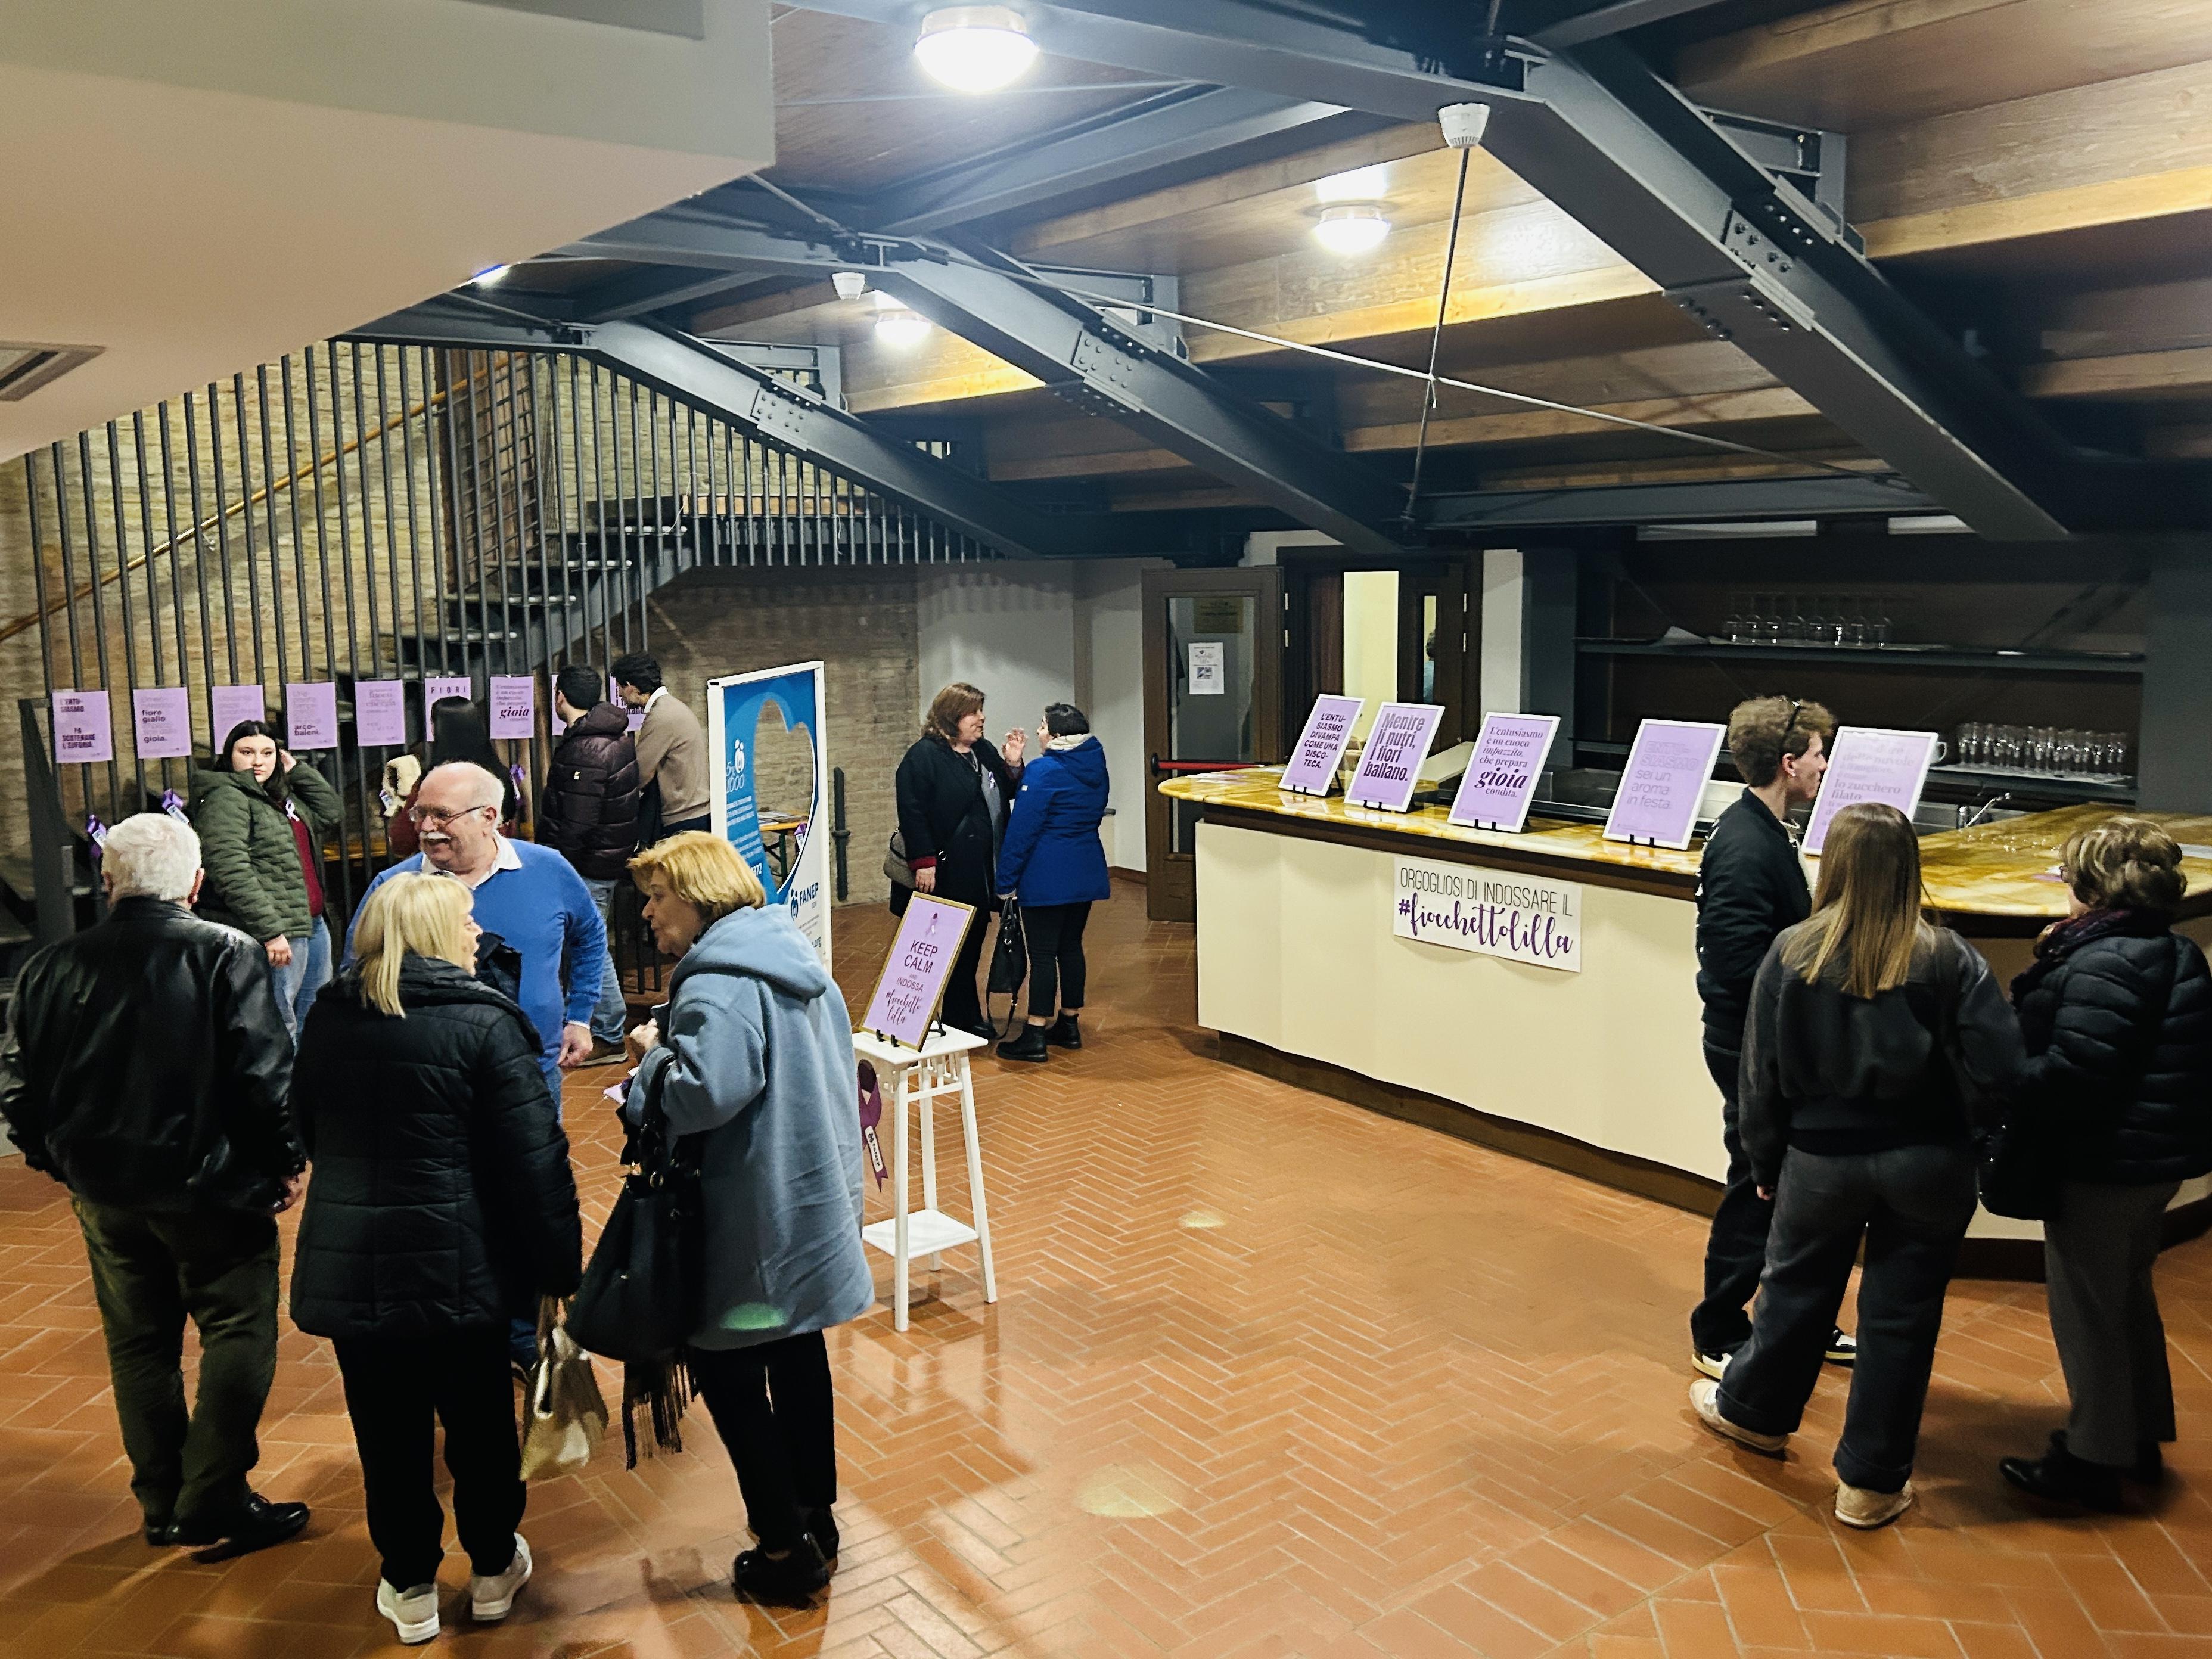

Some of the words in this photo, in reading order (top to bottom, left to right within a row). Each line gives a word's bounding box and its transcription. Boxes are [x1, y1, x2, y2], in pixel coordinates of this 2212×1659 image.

[142, 715, 166, 724] giallo
[499, 706, 530, 719] gioia
[1321, 713, 1346, 722] L'ENTU-
[1316, 722, 1343, 732] SIASMO
[1381, 713, 1425, 731] Mentre
[1310, 731, 1340, 741] DIVAMPA
[1375, 728, 1387, 744] li
[1385, 731, 1417, 749] nutri,
[1490, 726, 1543, 738] L'entusiasmo
[1304, 740, 1324, 749] COME
[1324, 742, 1338, 751] UNA
[1645, 741, 1691, 756] ENTU-
[1305, 750, 1328, 759] DISCO-
[1369, 744, 1377, 760] i
[1376, 745, 1403, 763] fiori
[1303, 759, 1321, 768] TECA.
[1479, 756, 1494, 765] che
[1494, 759, 1528, 768] prepara
[1640, 753, 1698, 771] SIASMO
[1363, 761, 1408, 781] ballano.
[1474, 767, 1528, 789] gioia
[1635, 768, 1654, 779] sei
[1655, 772, 1671, 781] un
[1485, 787, 1518, 797] condita.
[1631, 782, 1670, 796] aroma
[1834, 779, 1846, 788] lo
[1847, 781, 1901, 794] zucchero
[1627, 794, 1638, 804] in
[1831, 789, 1862, 800] filato
[799, 882, 819, 906] FANEP
[1400, 867, 1464, 898] ORGOGLIOSI
[1467, 878, 1477, 900] DI
[1484, 881, 1557, 914] INDOSSARE
[1562, 893, 1573, 917] IL
[1398, 892, 1573, 958] #fiocchettolilla
[909, 940, 938, 958] KEEP
[904, 955, 934, 974] CALM
[896, 977, 924, 992] INDOSSA
